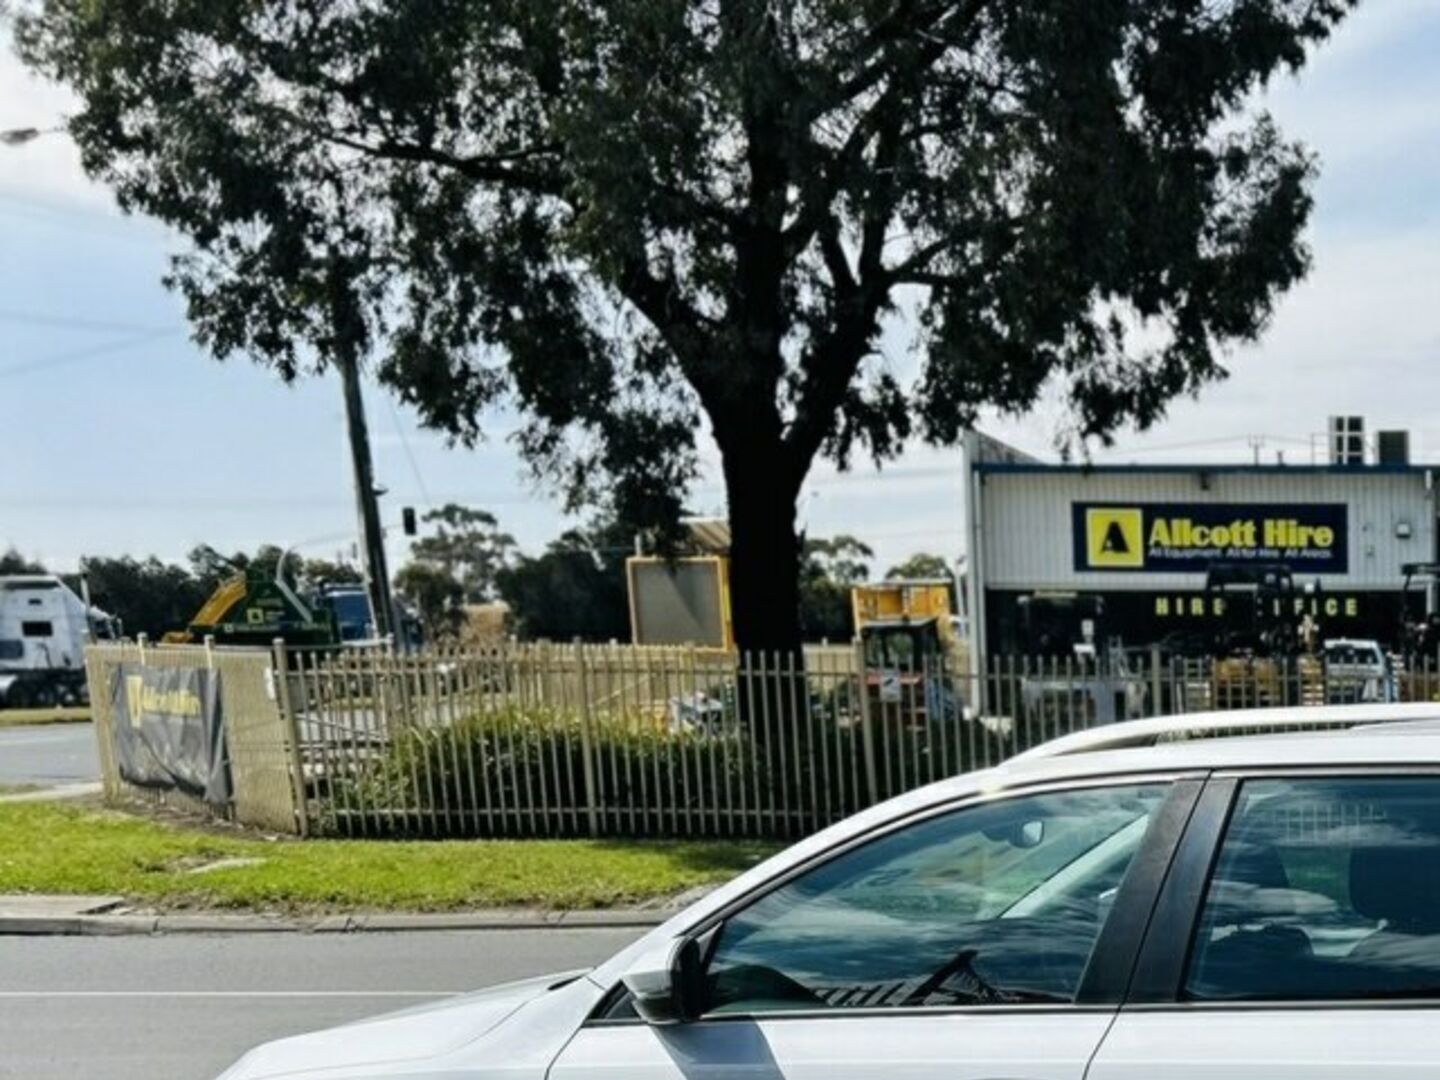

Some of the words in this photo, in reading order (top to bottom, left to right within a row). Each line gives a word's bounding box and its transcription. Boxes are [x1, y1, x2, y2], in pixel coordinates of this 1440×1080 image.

[1150, 518, 1257, 547] Allcott
[1263, 519, 1334, 547] Hire
[1156, 598, 1224, 616] HIRE
